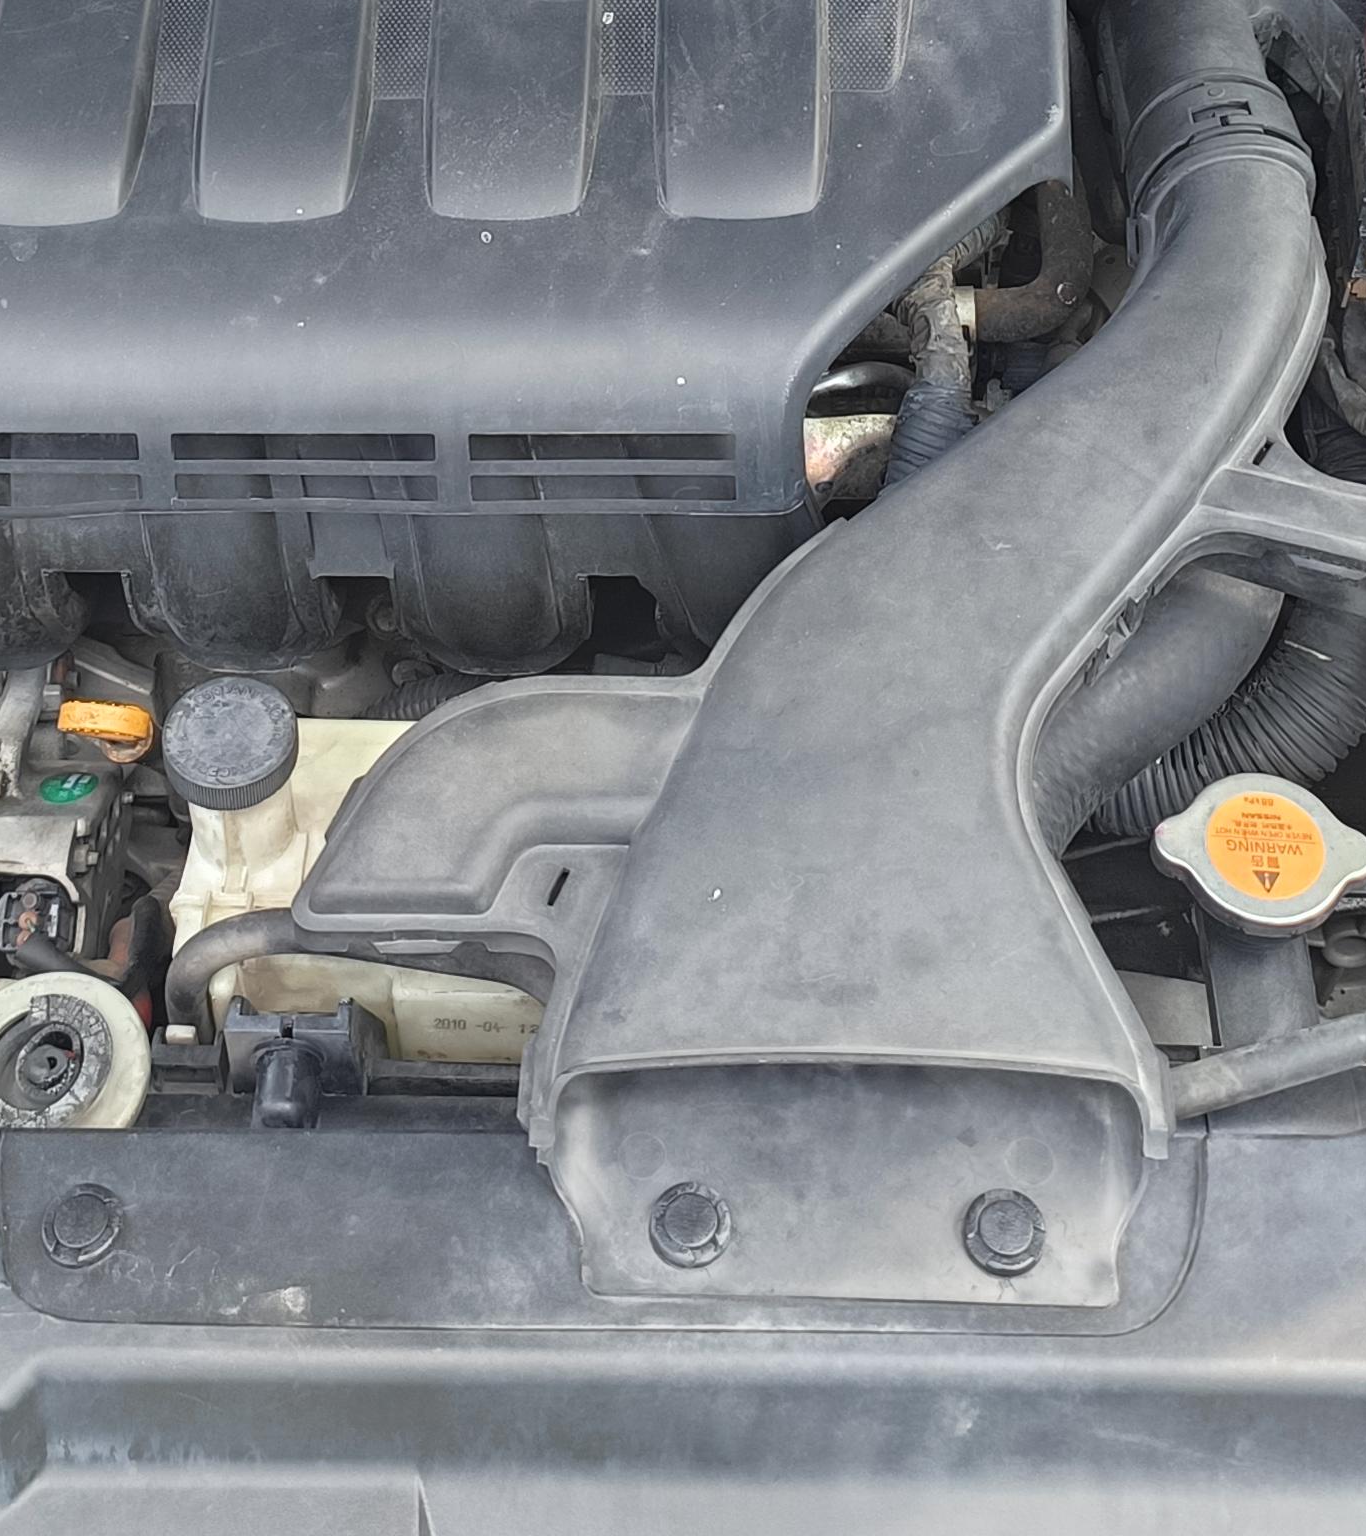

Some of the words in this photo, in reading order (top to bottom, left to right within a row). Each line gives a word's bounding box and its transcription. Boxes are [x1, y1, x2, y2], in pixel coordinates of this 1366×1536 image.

[1233, 827, 1259, 836] WHEN
[1286, 832, 1313, 840] NEVER
[1226, 839, 1303, 856] WARNING
[433, 1017, 467, 1031] 2010
